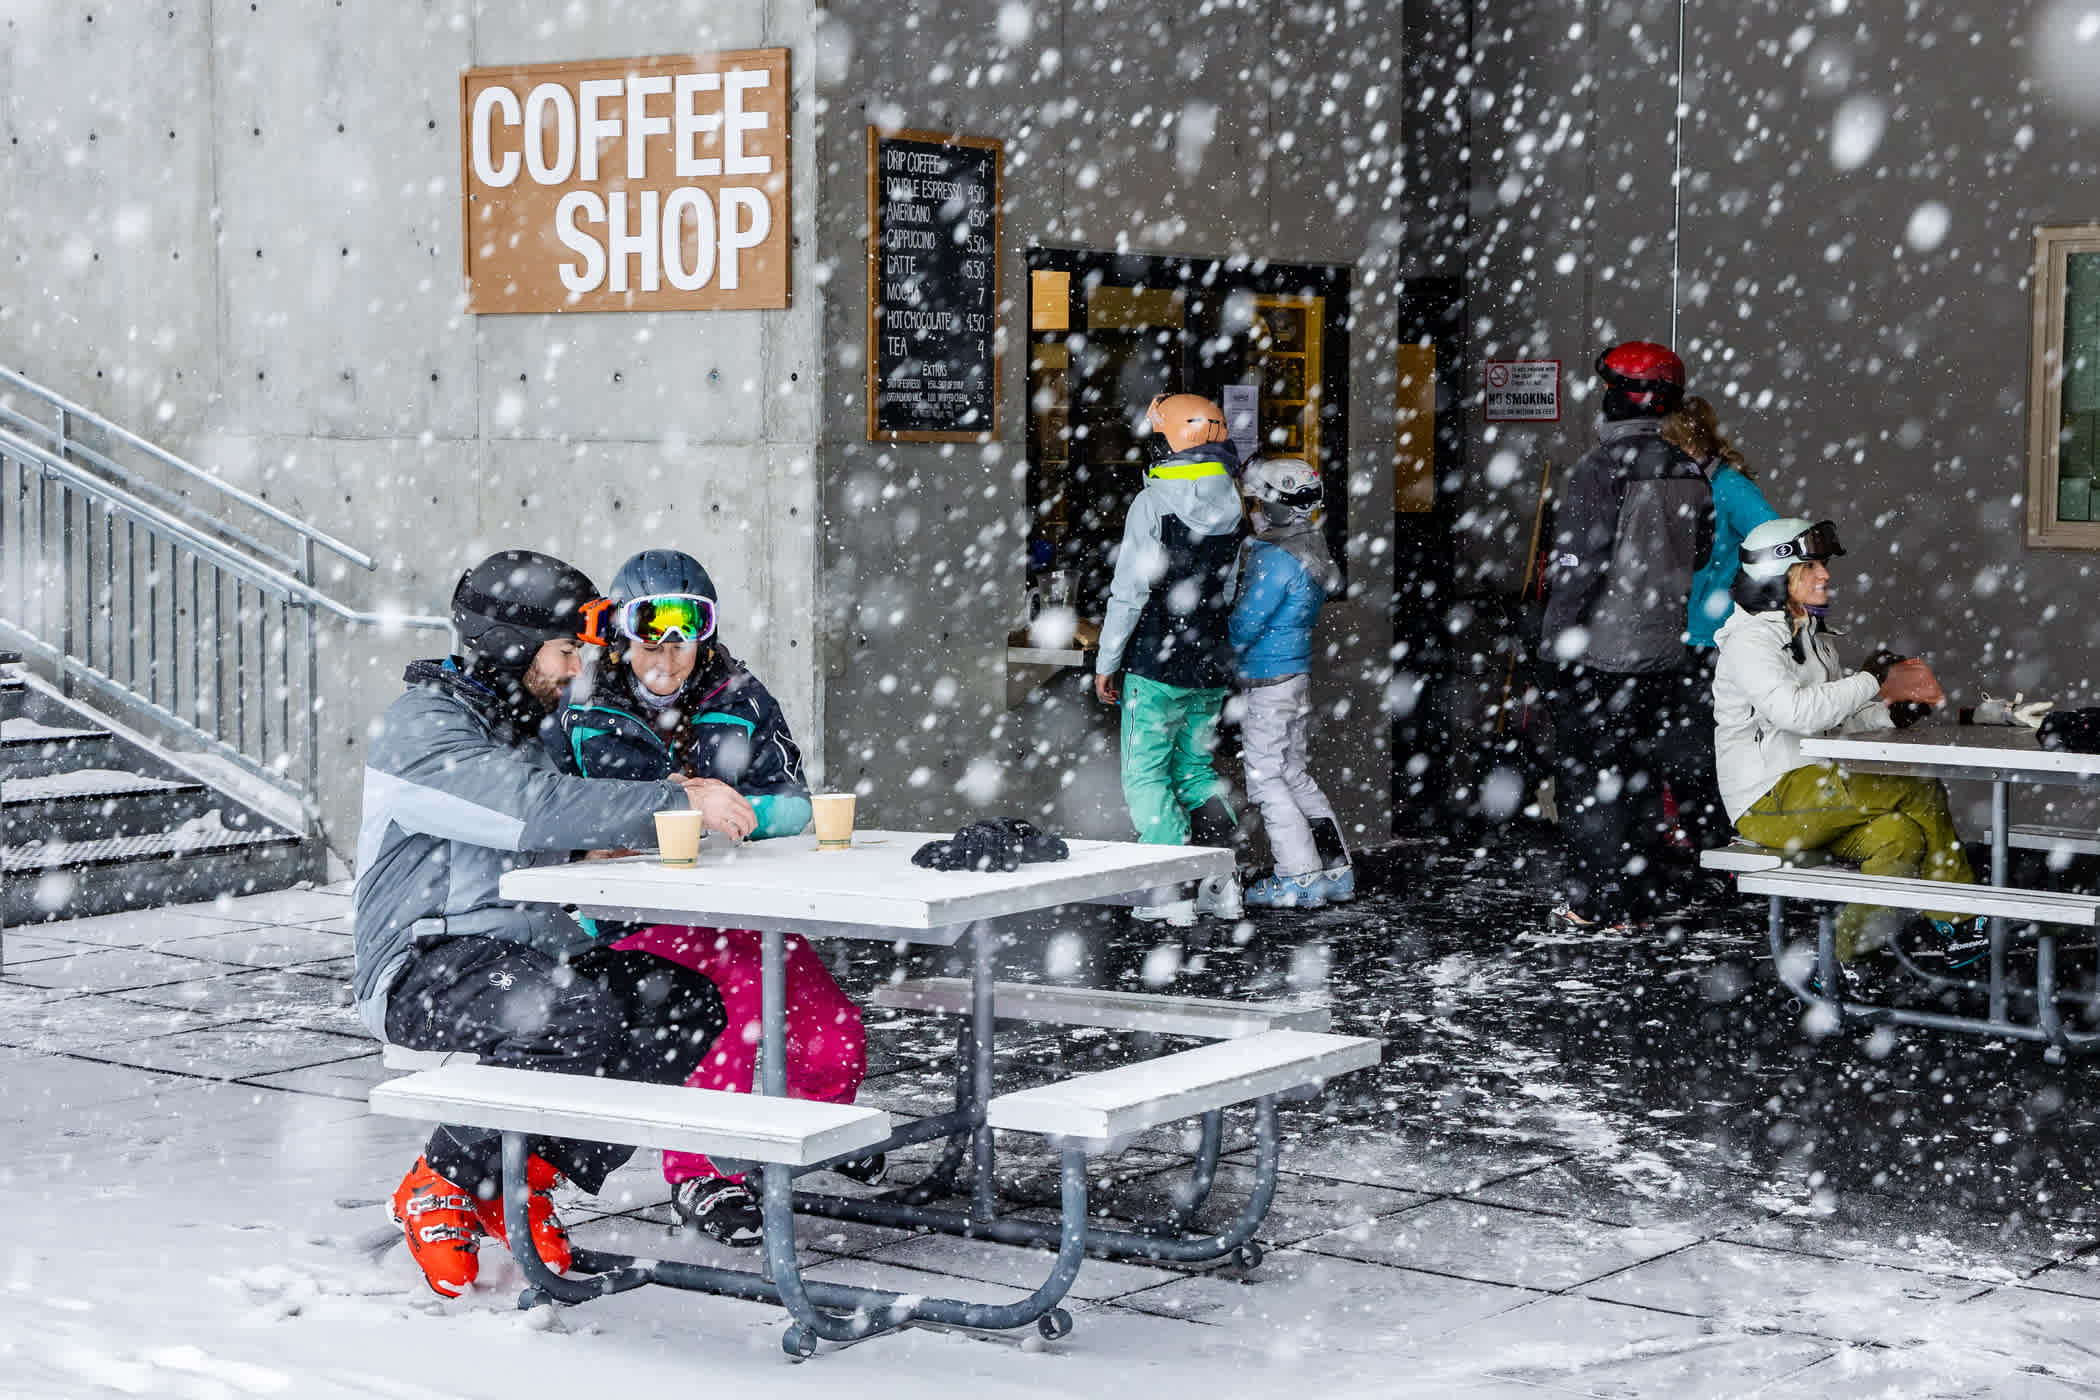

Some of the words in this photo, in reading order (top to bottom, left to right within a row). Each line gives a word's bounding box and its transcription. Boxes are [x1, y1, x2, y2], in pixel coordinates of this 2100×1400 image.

[471, 69, 772, 188] COFFEE
[887, 150, 907, 170] DRIP
[907, 151, 941, 174] COFFEE
[978, 160, 985, 178] 4
[886, 176, 920, 198] DOUBLE
[922, 180, 962, 200] ESPRESSO
[886, 202, 931, 223] AMERICANO
[555, 186, 772, 293] SHOP
[886, 228, 936, 249] CAPPUCCINO
[887, 255, 917, 275] LATTE
[966, 260, 985, 279] 5.50
[977, 287, 985, 305] 7
[887, 310, 904, 329] HOT
[904, 310, 952, 330] CHOCOLATE
[887, 336, 908, 356] TEA
[1488, 392, 1503, 405] NO
[1505, 392, 1555, 405] SMOKING
